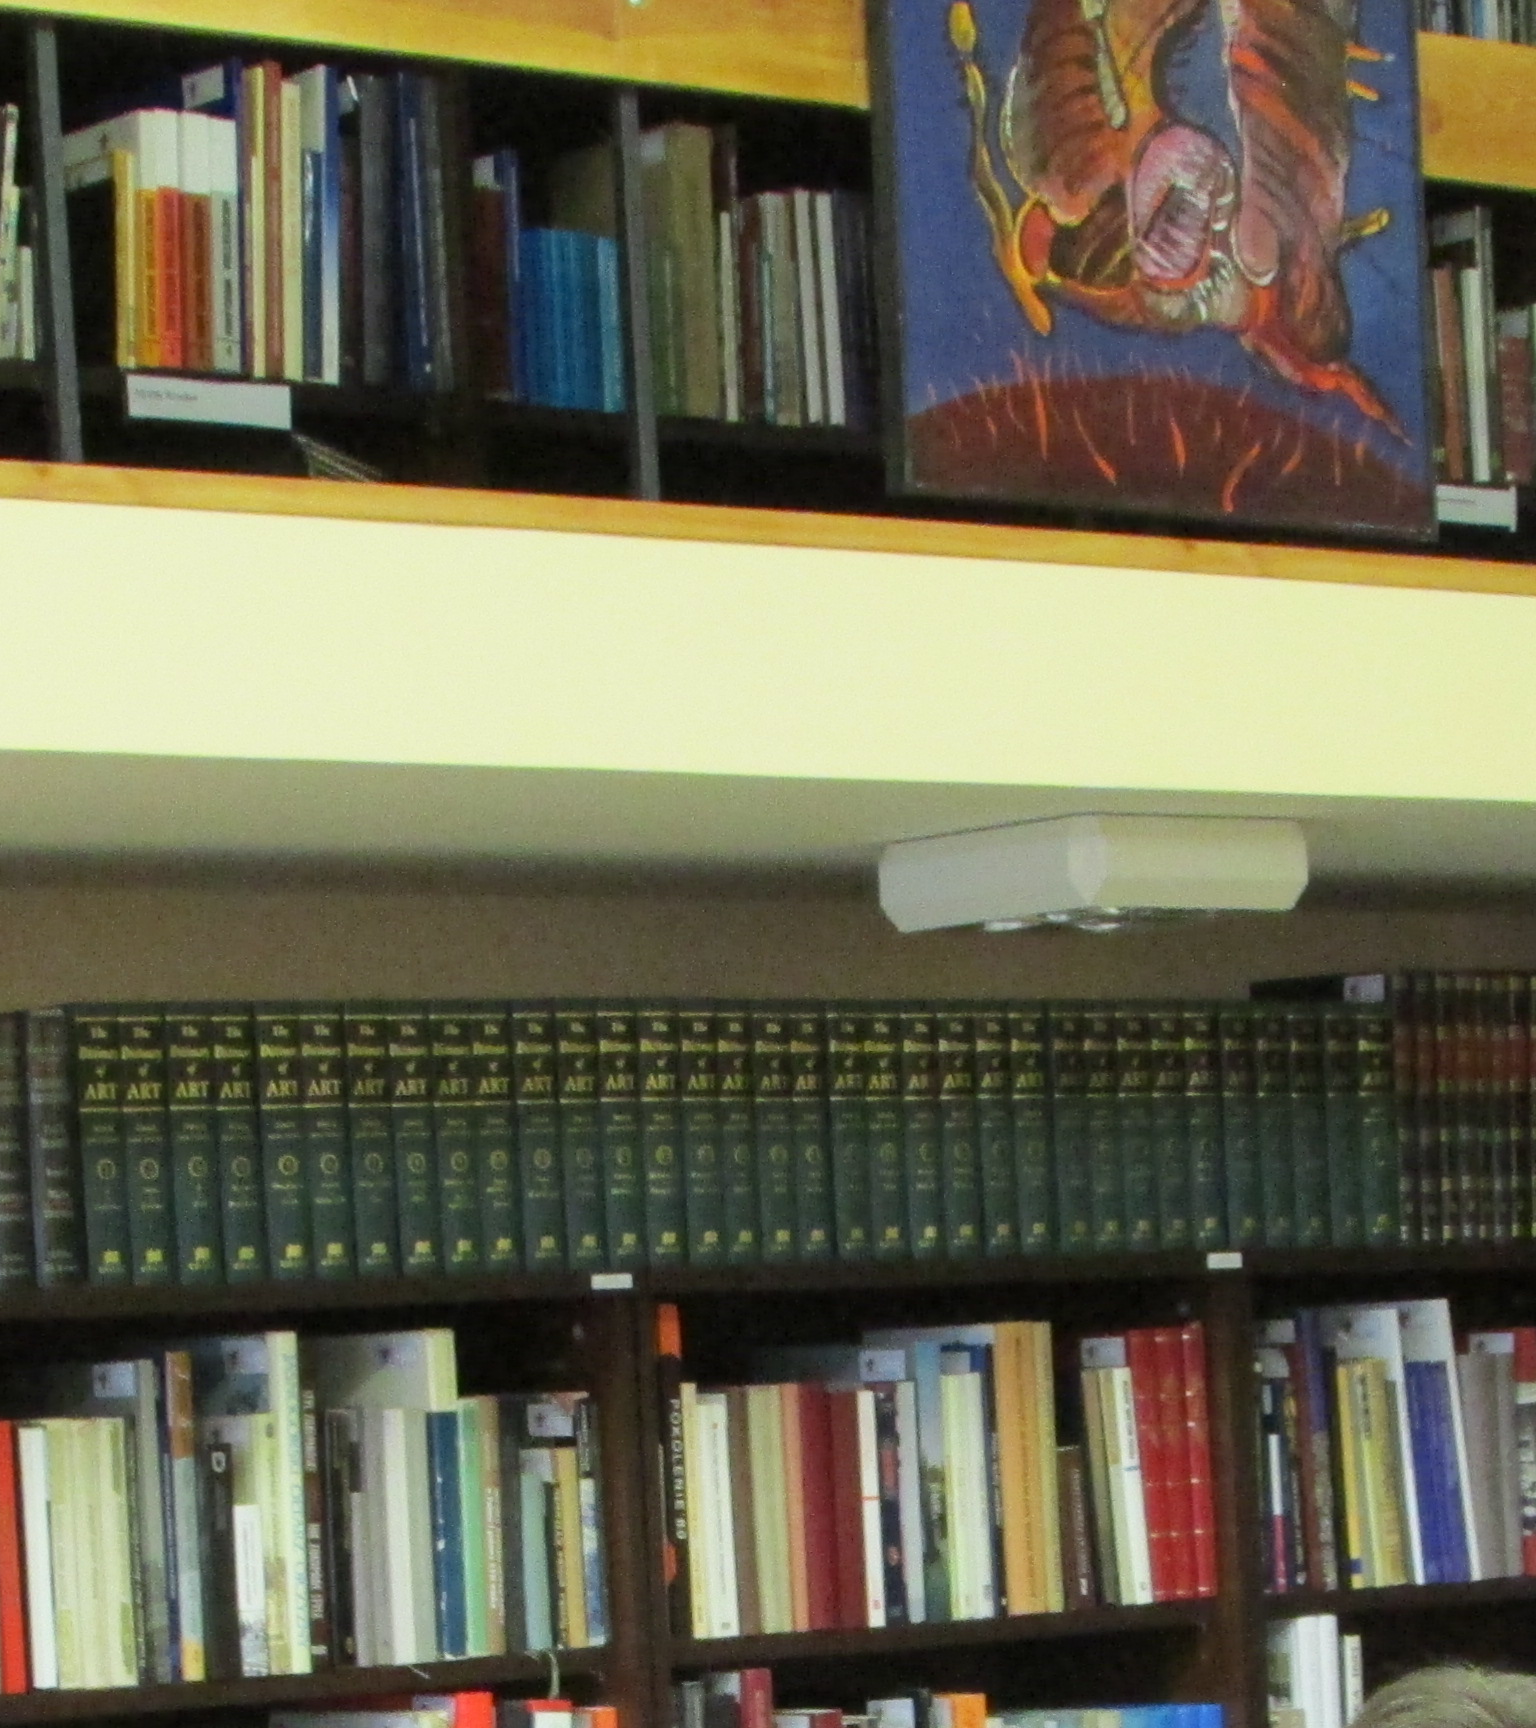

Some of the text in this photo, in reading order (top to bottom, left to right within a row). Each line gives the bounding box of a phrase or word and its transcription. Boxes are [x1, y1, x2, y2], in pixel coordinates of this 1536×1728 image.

[127, 1082, 162, 1100] ART
[175, 1081, 209, 1099] ART
[219, 1081, 251, 1099] ART
[266, 1080, 298, 1098] ART
[307, 1080, 342, 1096] ART
[353, 1079, 385, 1096] ART
[395, 1078, 428, 1095] ART
[438, 1078, 469, 1095] ART
[479, 1077, 510, 1094] ART
[521, 1076, 552, 1092] ART
[564, 1075, 594, 1092] ART
[605, 1075, 635, 1091] ART
[646, 1075, 676, 1090] ART
[687, 1075, 715, 1091] ART
[84, 1083, 117, 1100] ART
[670, 1399, 686, 1511] POKOLENIE
